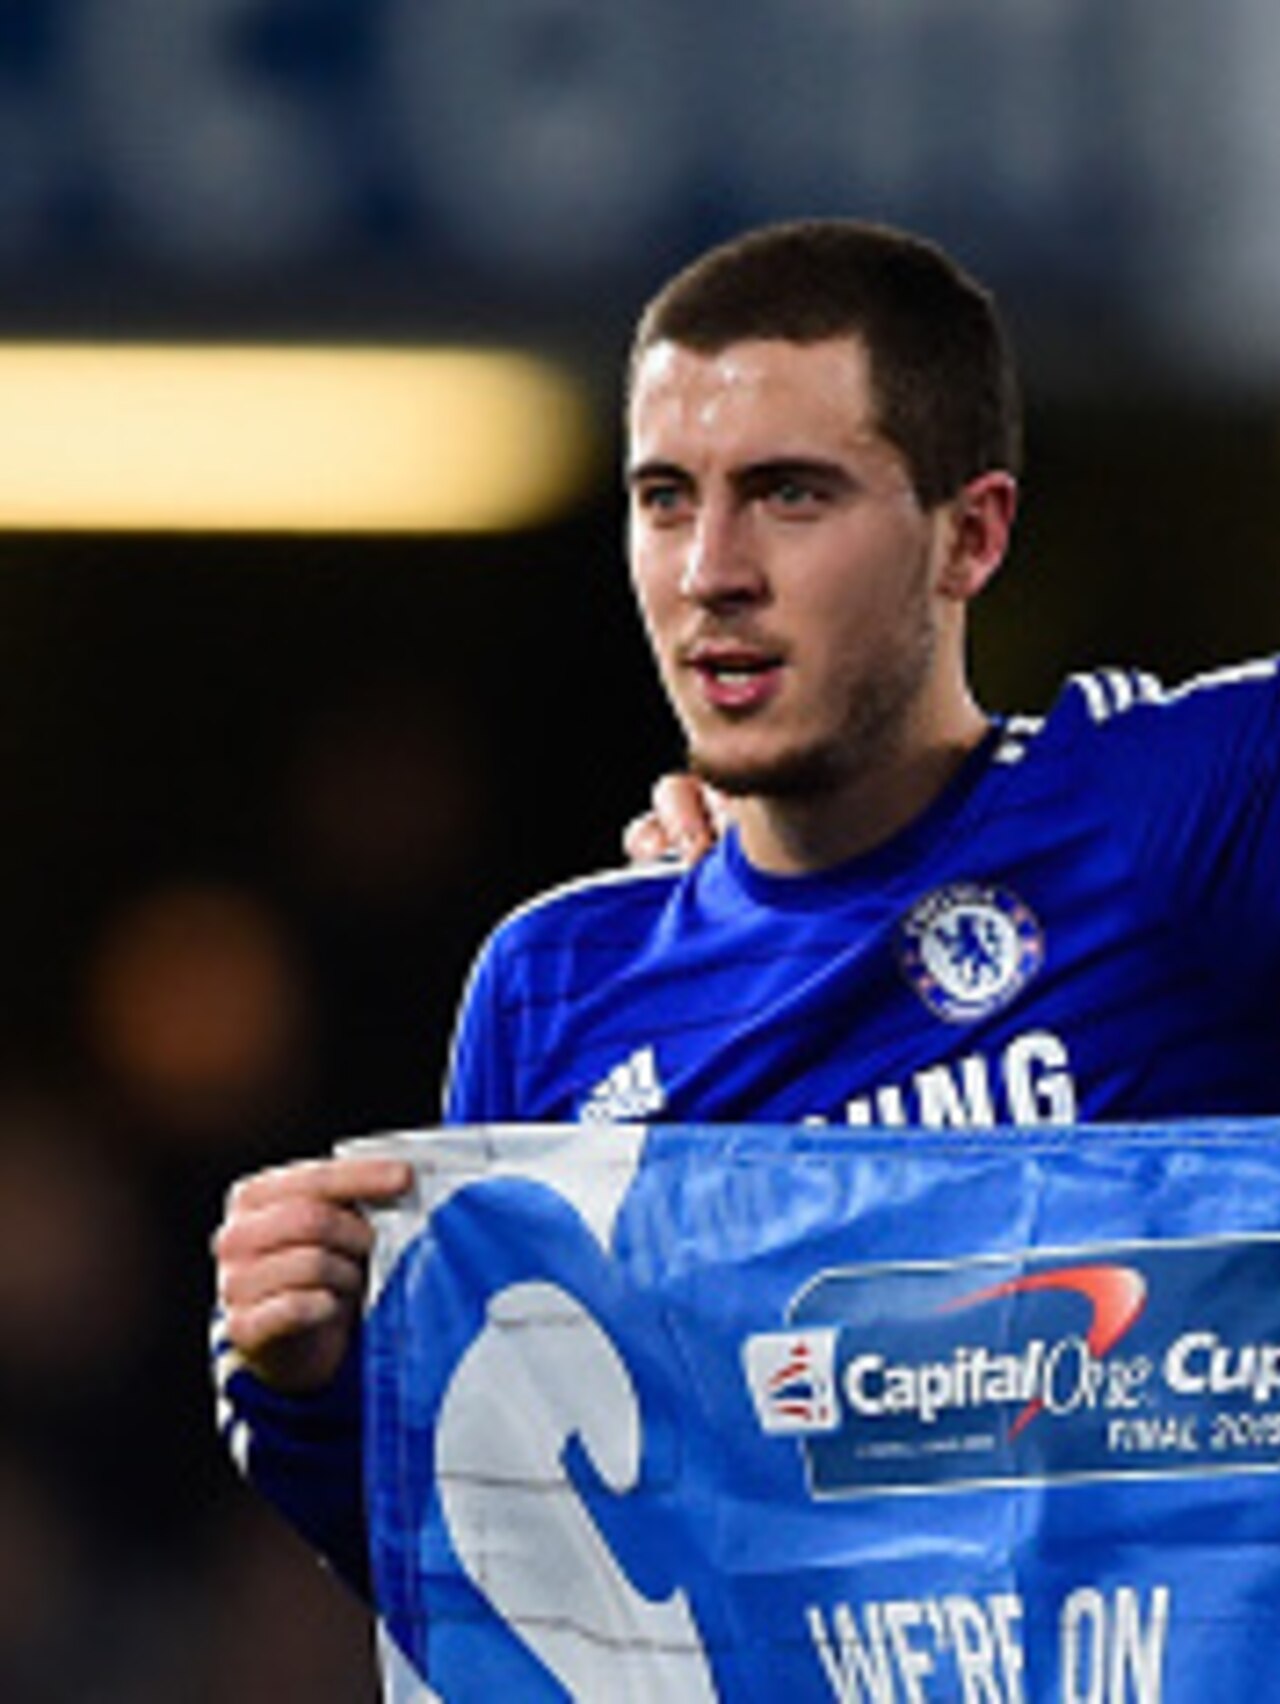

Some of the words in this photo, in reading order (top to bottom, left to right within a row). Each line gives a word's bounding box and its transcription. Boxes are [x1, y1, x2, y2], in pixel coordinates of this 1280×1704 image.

[1108, 1413, 1198, 1451] FINAL
[806, 1594, 1025, 1704] WE'RE
[1061, 1586, 1170, 1704] ON
